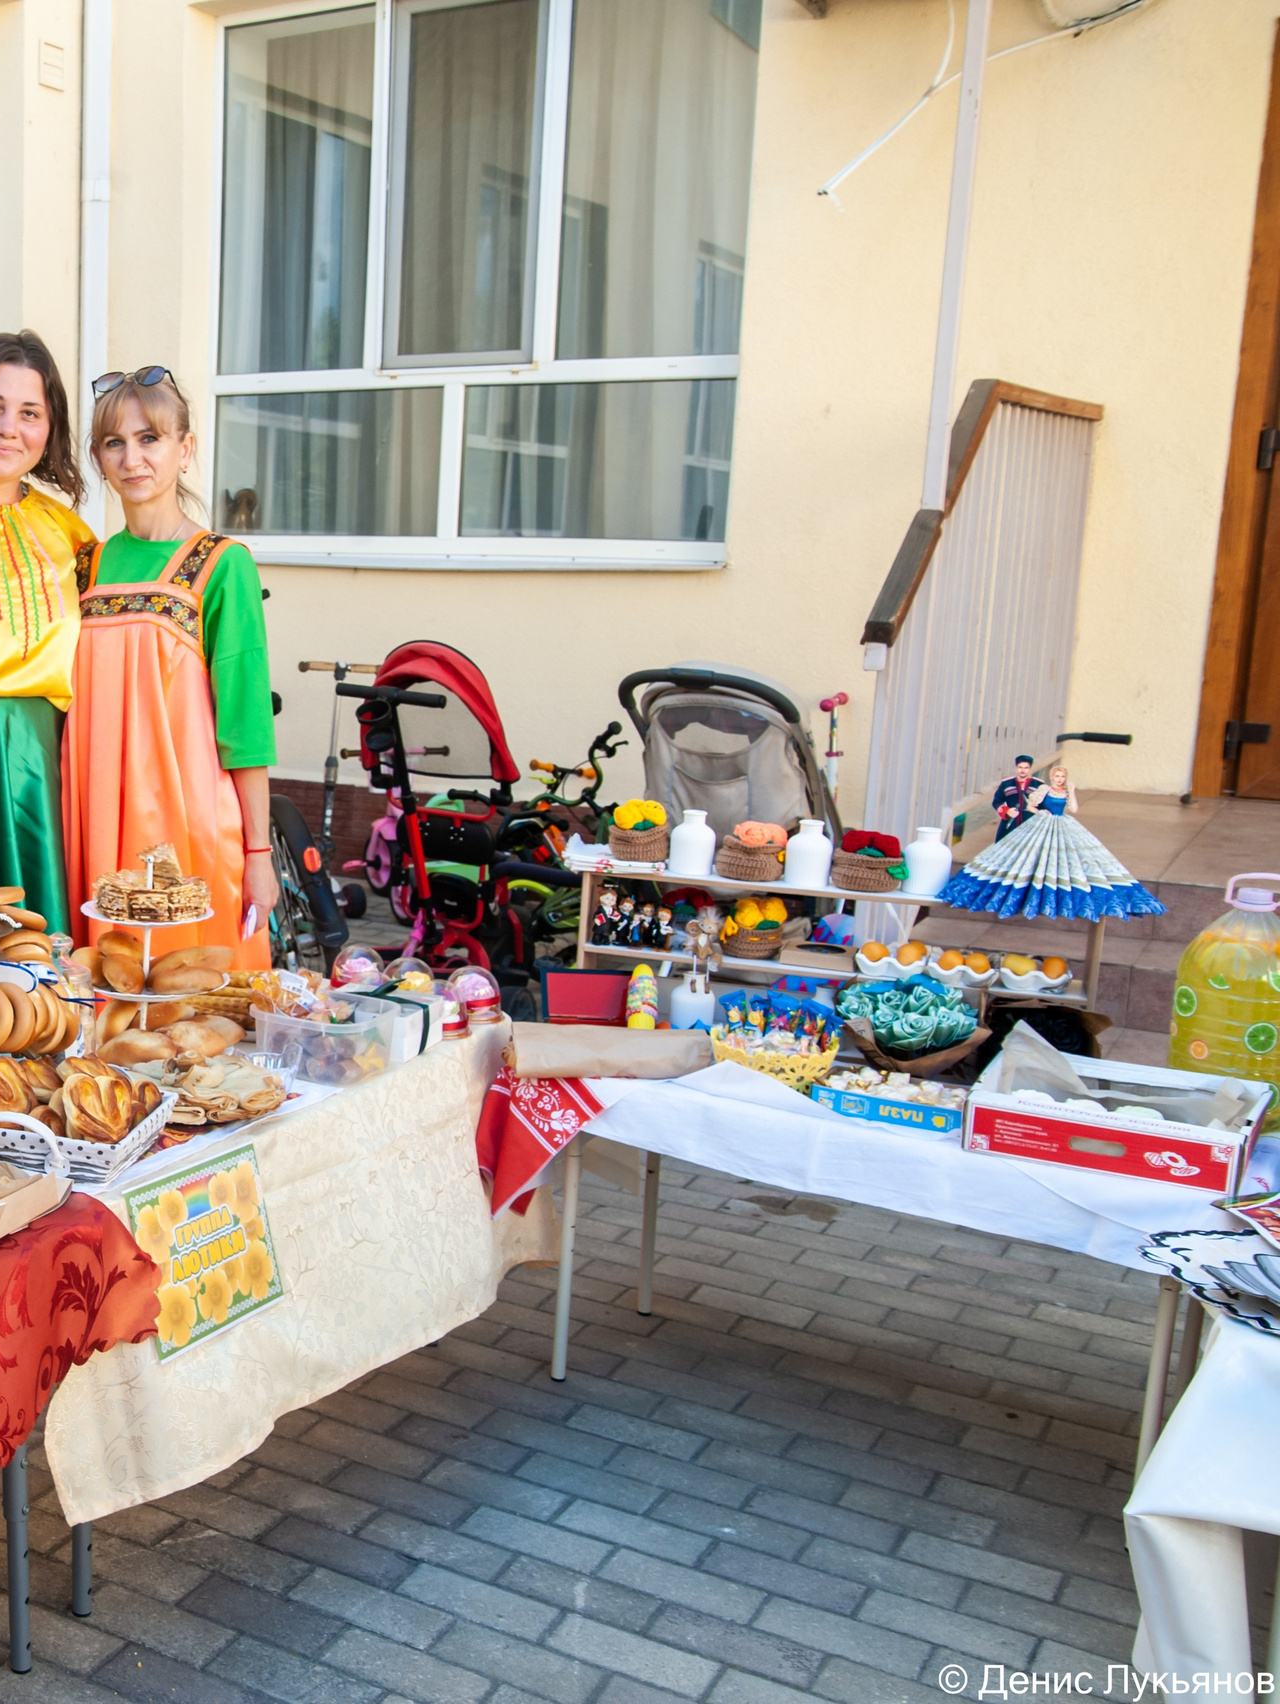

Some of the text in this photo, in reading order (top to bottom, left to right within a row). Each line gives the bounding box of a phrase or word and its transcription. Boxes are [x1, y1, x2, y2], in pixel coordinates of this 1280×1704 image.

[879, 1104, 924, 1123] ПАЗЛ
[174, 1206, 233, 1248] ГРУППА
[172, 1227, 247, 1284] ЛЮТИКИ
